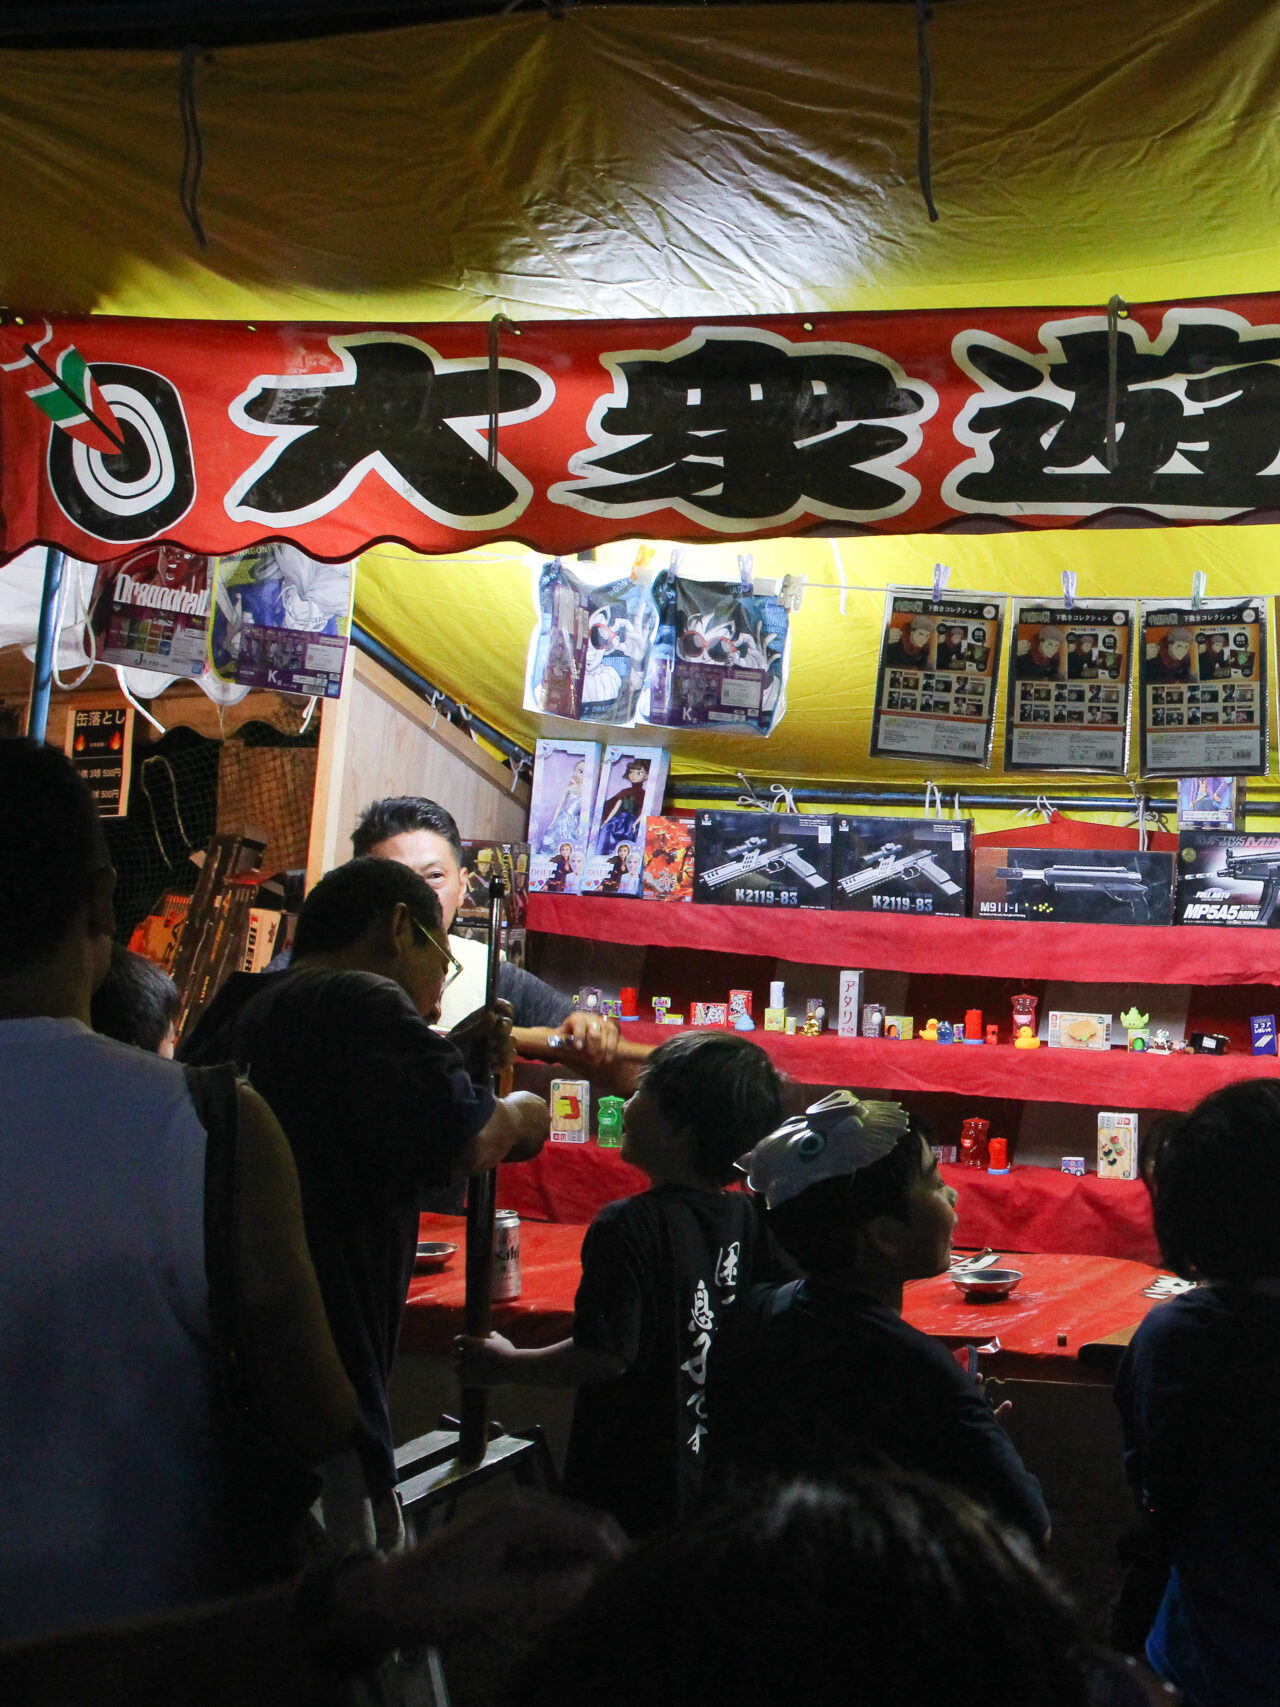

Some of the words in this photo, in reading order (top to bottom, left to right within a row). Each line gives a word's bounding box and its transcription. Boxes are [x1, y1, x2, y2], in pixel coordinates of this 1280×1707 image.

[76, 710, 125, 727] 缶落とし
[735, 888, 798, 905] K2119-83
[872, 895, 934, 912] K2119-83
[1183, 904, 1240, 920] MP5A5
[1237, 910, 1260, 920] MINI
[843, 980, 856, 1025] アタリ
